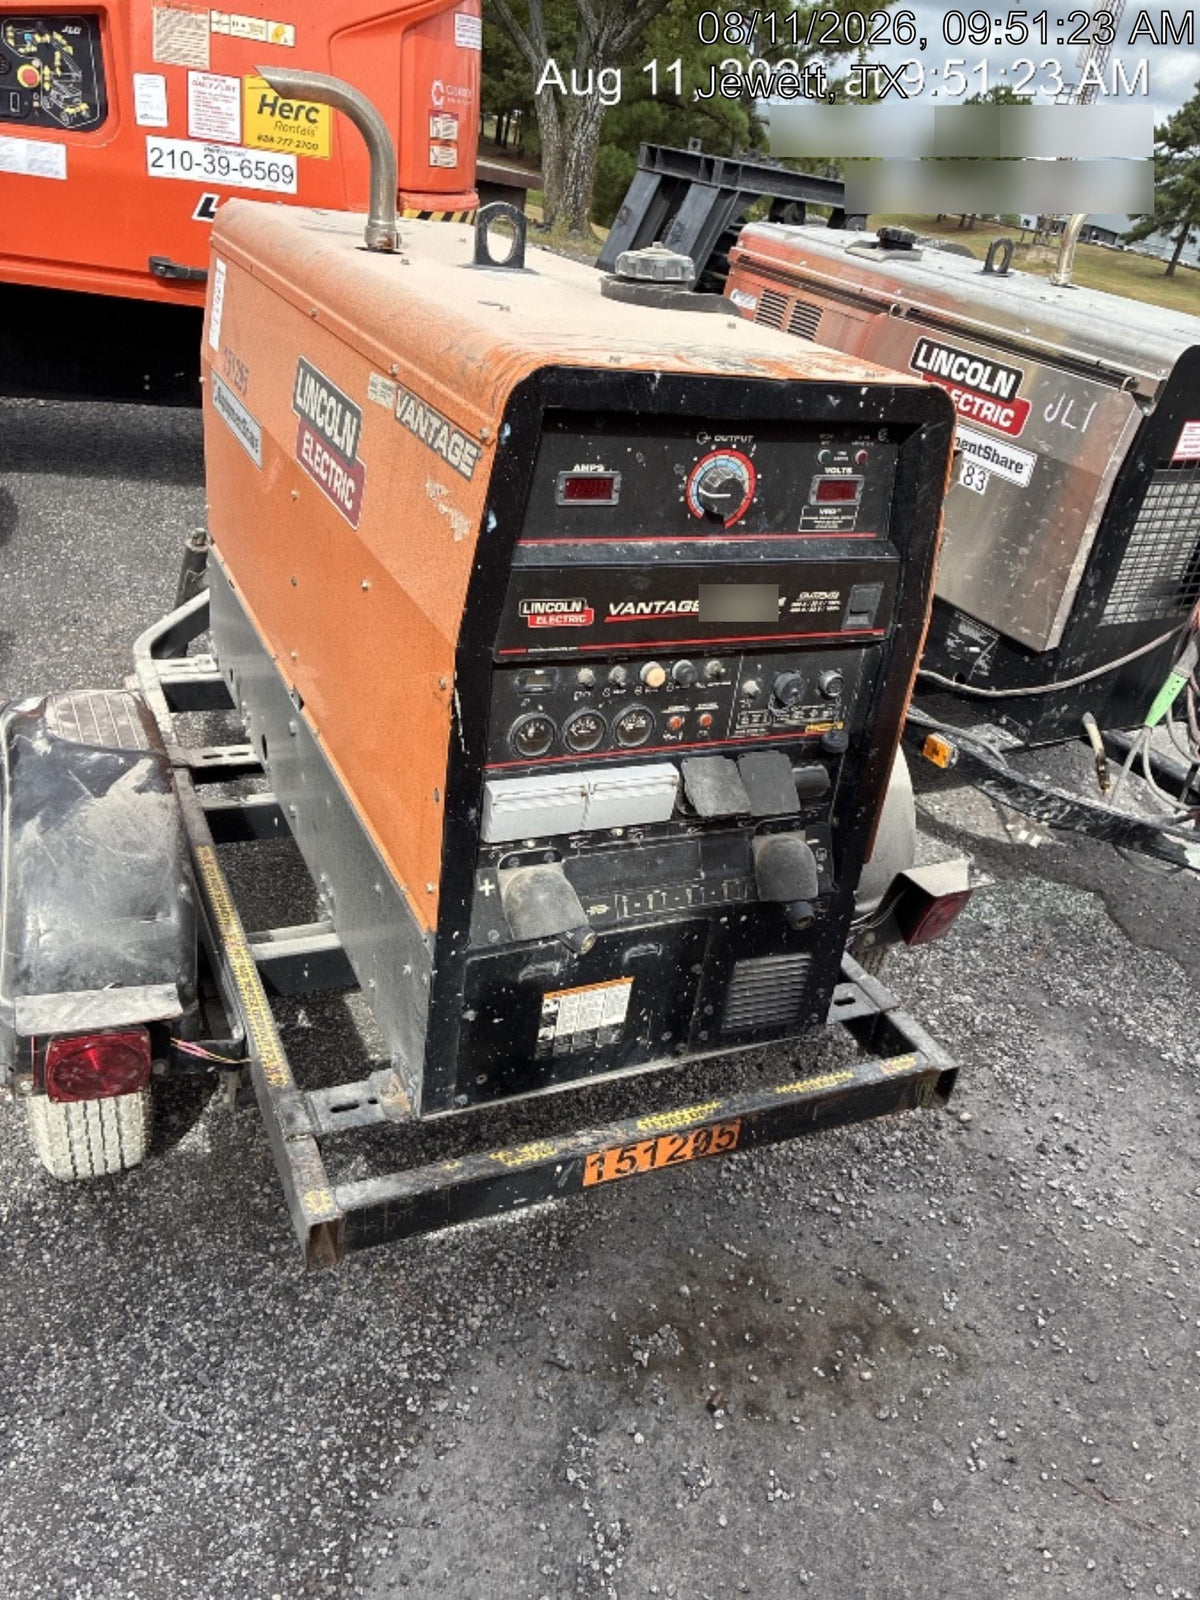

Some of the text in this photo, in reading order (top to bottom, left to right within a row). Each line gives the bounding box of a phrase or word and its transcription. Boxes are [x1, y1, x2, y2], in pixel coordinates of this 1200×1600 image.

[257, 94, 320, 124] Herc
[274, 121, 317, 137] Rentals
[150, 147, 294, 185] 210-39-6569
[915, 343, 1016, 398] LINCOLN
[296, 367, 358, 457] LINCOLN
[951, 388, 1015, 427] ECTRIC
[396, 389, 478, 477] VANTAGE
[714, 435, 755, 443] OUTPUT
[301, 429, 356, 511] ELECTRIC
[571, 463, 606, 472] AMPS
[963, 465, 986, 491] 83
[522, 600, 583, 614] LINCOLN
[535, 613, 587, 625] ELECTRIC
[608, 600, 700, 616] VANTAGE
